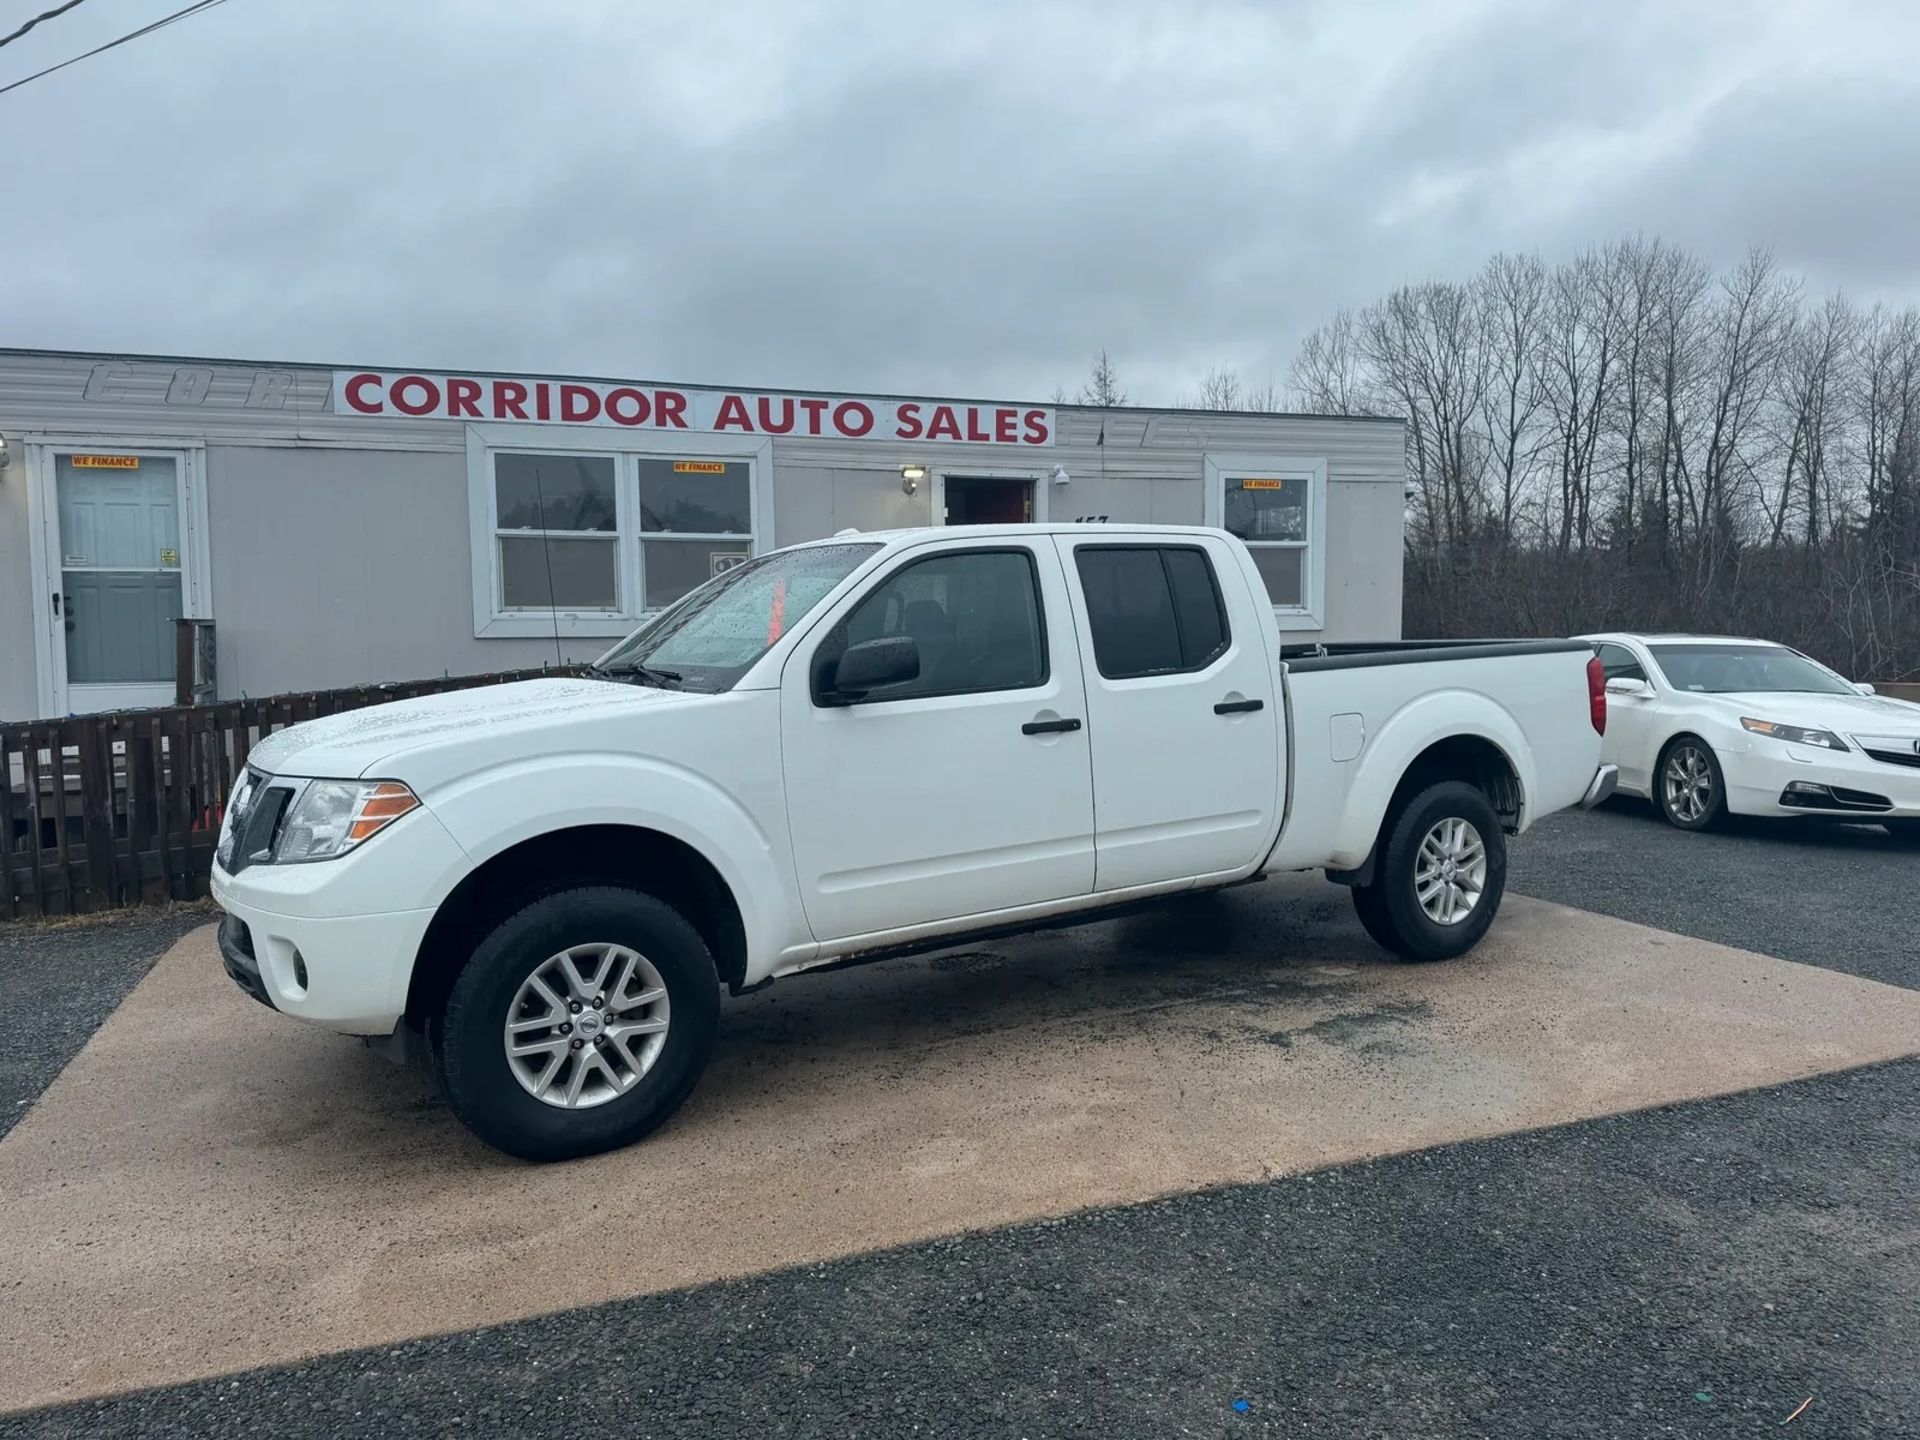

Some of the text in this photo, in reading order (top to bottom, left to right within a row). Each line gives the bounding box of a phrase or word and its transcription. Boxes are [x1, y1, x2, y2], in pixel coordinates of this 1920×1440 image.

[345, 373, 689, 428] CORRIDOR
[713, 395, 875, 437] AUTO
[895, 403, 1049, 445] SALES
[73, 456, 137, 466] WE FINANCE
[688, 463, 722, 471] FINANCE
